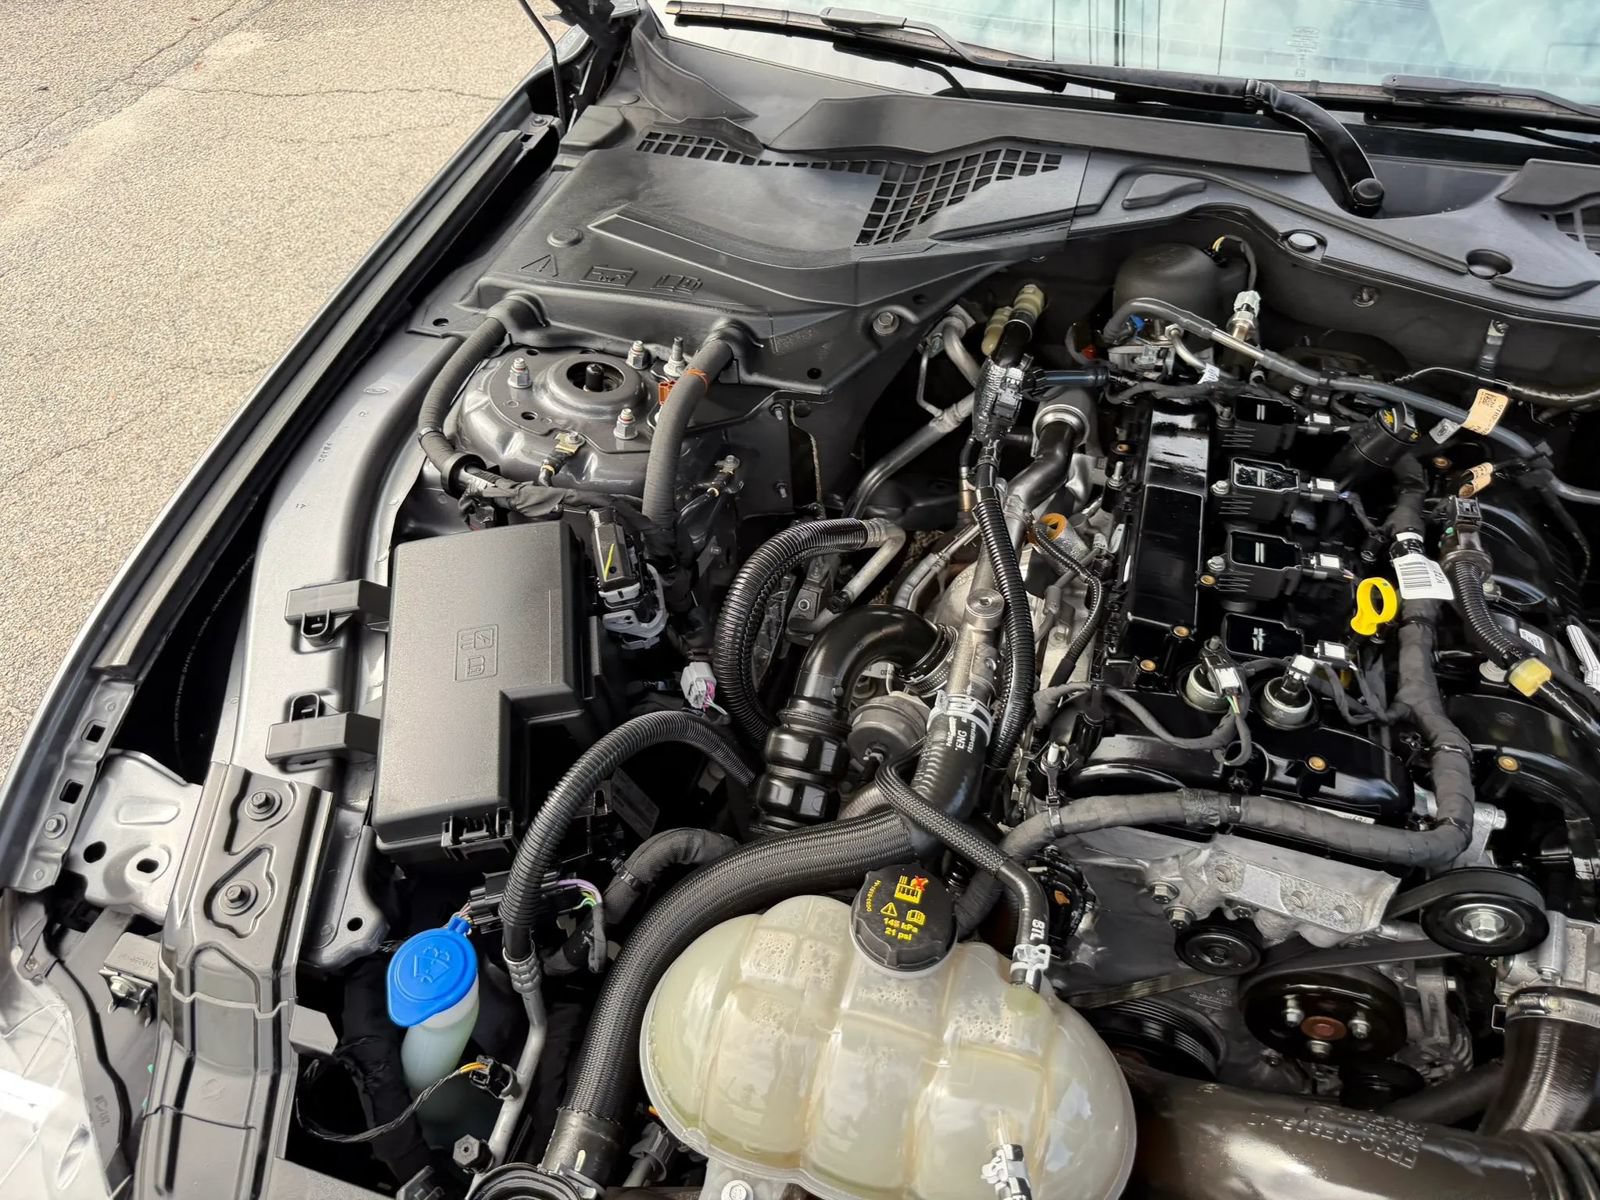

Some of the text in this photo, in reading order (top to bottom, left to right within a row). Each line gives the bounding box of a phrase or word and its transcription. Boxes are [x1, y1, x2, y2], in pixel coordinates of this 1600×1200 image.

[955, 729, 968, 750] ENG
[884, 927, 913, 941] 21 psi
[900, 921, 919, 934] kPa
[1029, 918, 1046, 941] BTL
